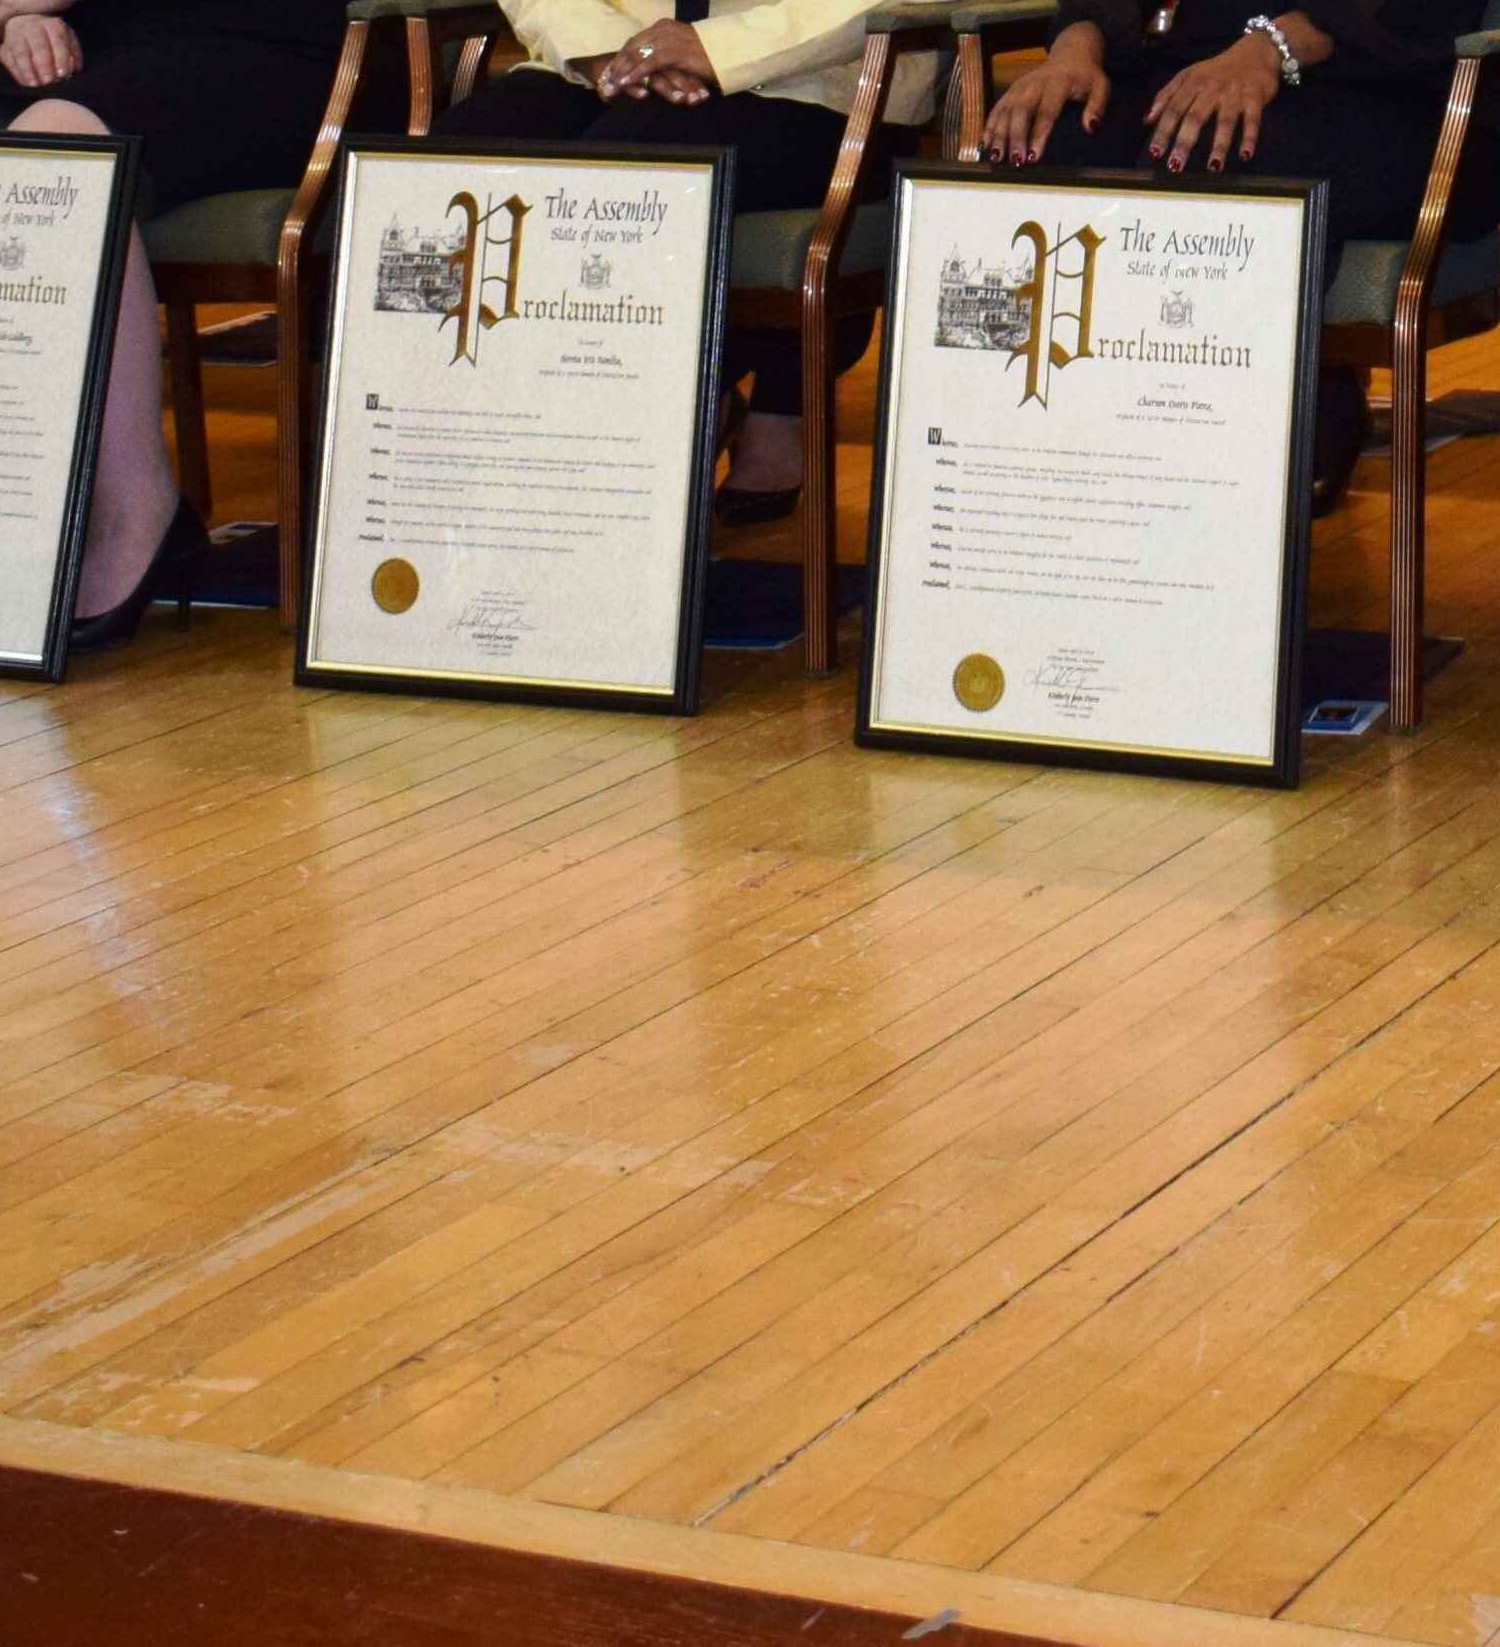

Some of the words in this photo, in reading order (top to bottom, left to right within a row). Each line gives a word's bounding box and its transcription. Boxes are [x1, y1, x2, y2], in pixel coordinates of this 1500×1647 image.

[1, 208, 12, 230] of
[13, 212, 34, 226] New
[35, 211, 56, 227] York
[5, 176, 79, 219] Assembly
[545, 188, 577, 220] The
[583, 190, 668, 235] Assembly
[550, 227, 577, 242] State
[580, 224, 593, 249] of
[594, 229, 617, 244] New
[620, 228, 643, 245] York
[1120, 219, 1156, 254] The
[1163, 223, 1255, 272] Assembly
[437, 190, 666, 368] Proclamation
[1127, 260, 1156, 277] State
[1160, 258, 1174, 284] of
[1175, 263, 1201, 279] New
[1204, 262, 1229, 281] York
[1004, 220, 1252, 412] Proclamation
